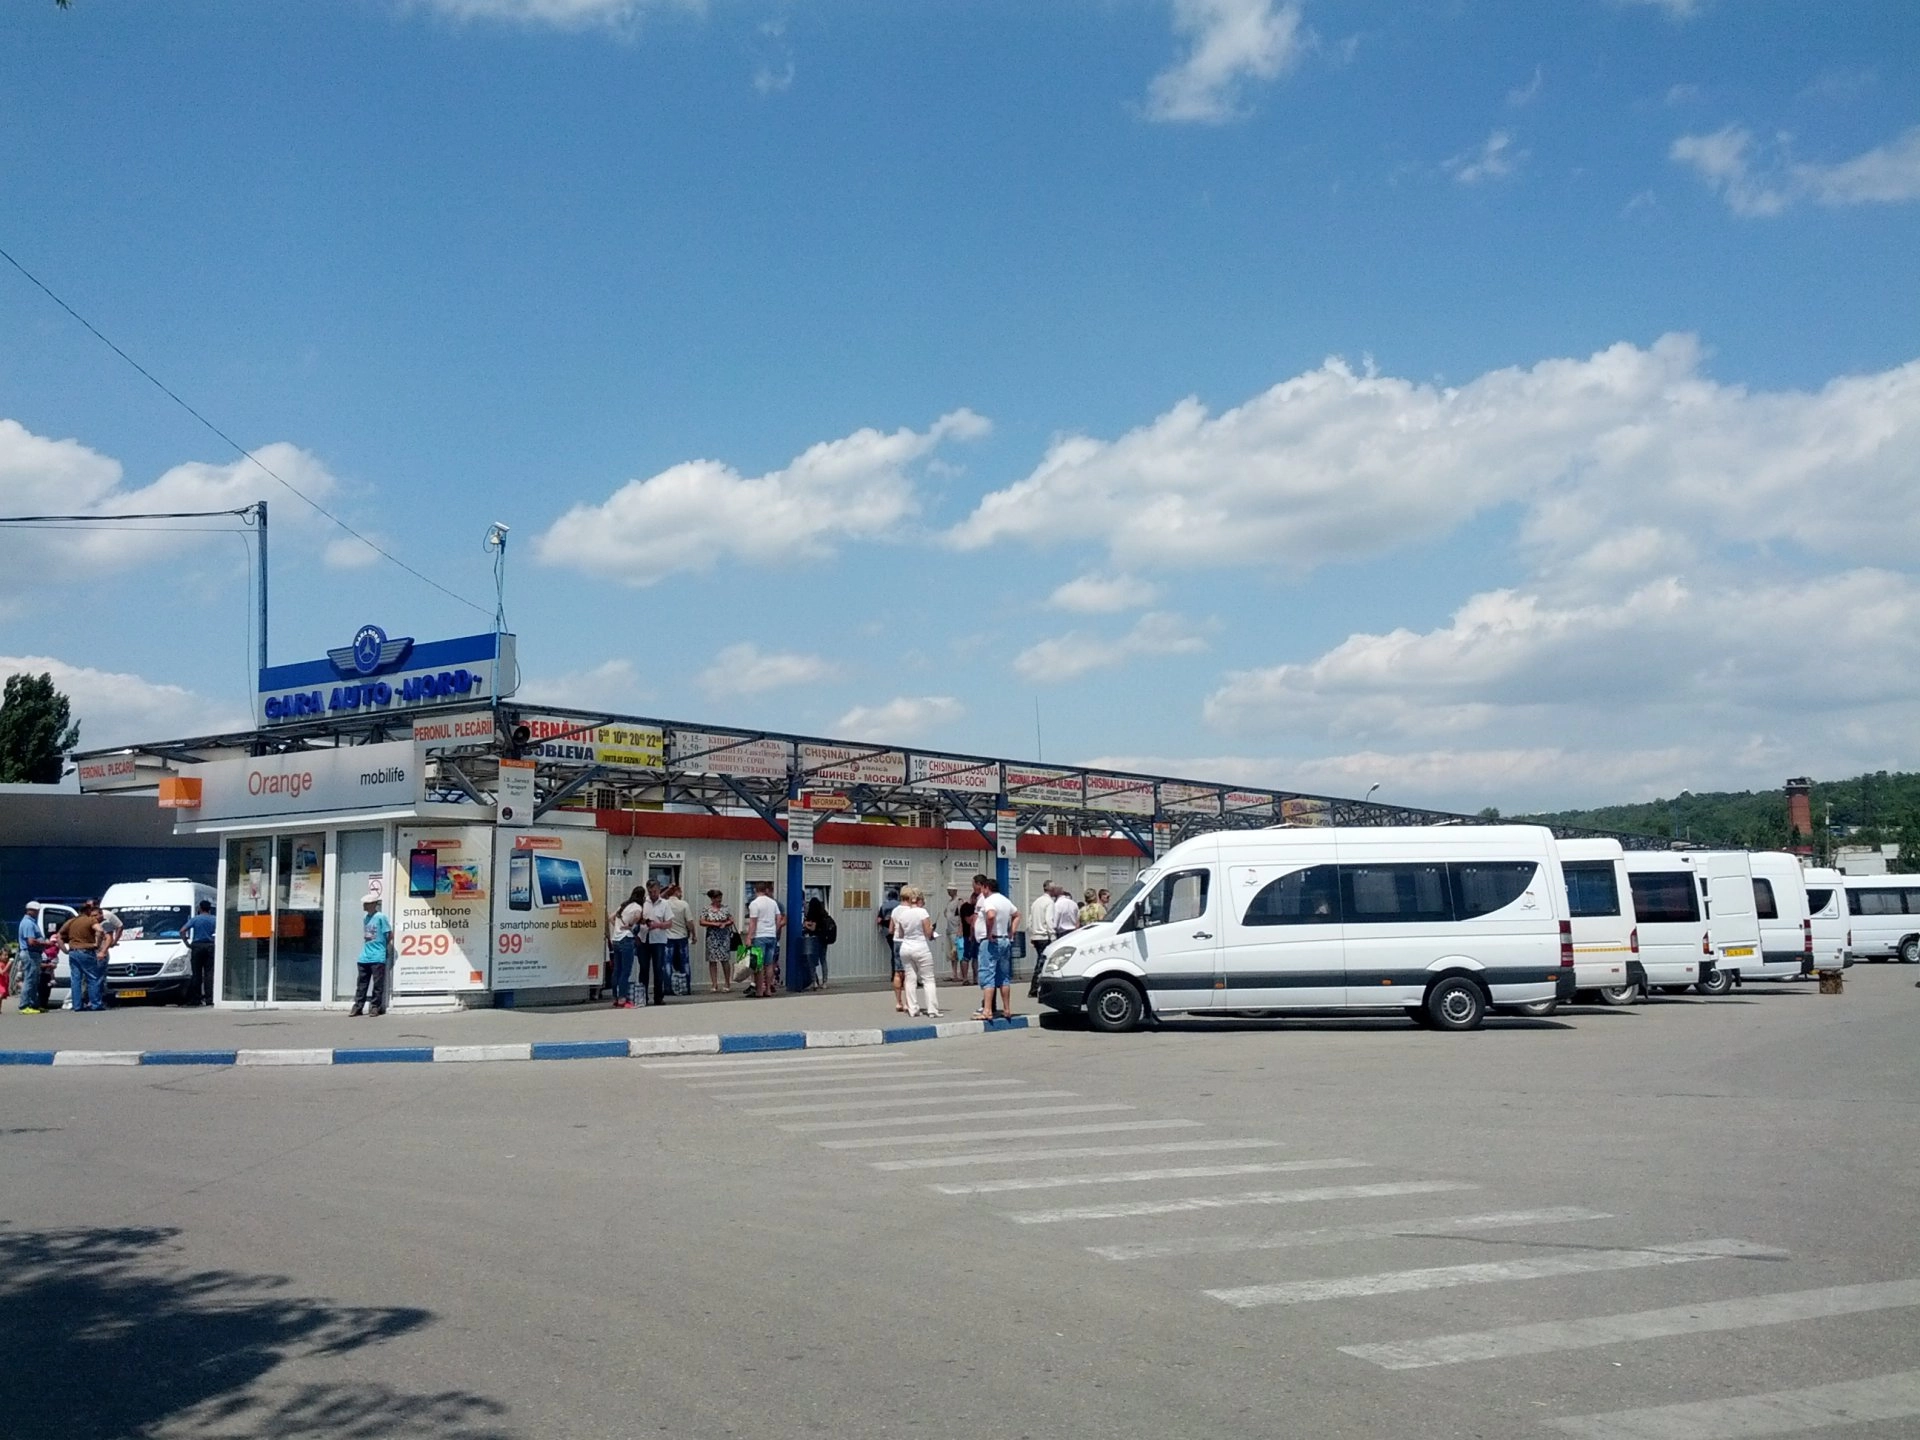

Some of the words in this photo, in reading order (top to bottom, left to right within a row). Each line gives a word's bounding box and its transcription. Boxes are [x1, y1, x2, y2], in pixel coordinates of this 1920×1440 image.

[265, 690, 326, 719] GARA
[328, 682, 392, 710] AUTO
[414, 723, 451, 740] PERONUL
[80, 764, 105, 779] PERONUL
[808, 768, 856, 781] ШИНЕВ
[864, 774, 903, 784] МОСКВА
[248, 771, 312, 797] Orange
[360, 767, 404, 785] mobilife
[403, 907, 471, 917] smartphone
[402, 920, 426, 931] plus
[430, 919, 469, 929] tabletă
[499, 920, 549, 930] smartphone
[551, 920, 568, 930] plus
[401, 934, 449, 956] 259
[453, 936, 464, 944] lei
[498, 933, 522, 954] 99
